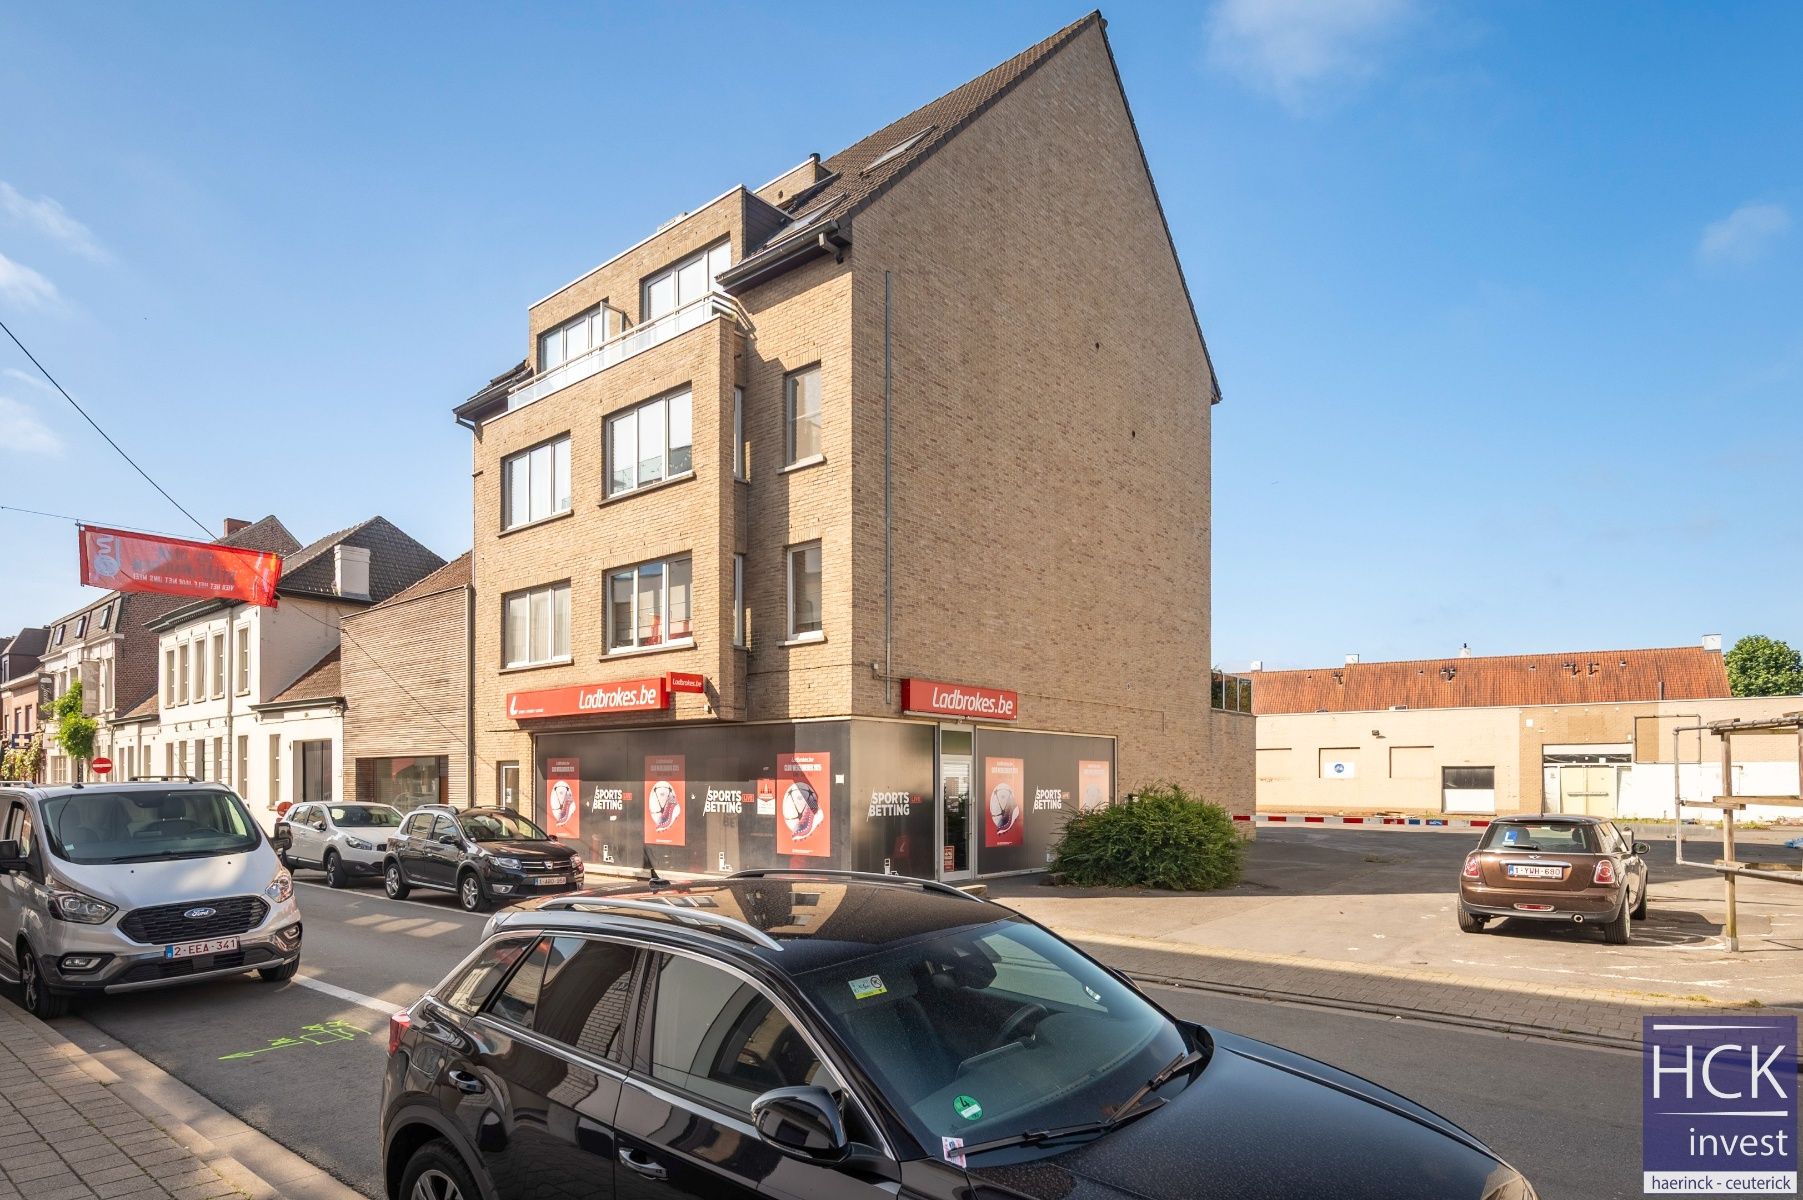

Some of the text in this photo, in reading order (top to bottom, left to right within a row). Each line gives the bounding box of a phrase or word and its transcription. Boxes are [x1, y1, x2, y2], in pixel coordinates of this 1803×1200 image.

[672, 677, 702, 688] Ladbrokes.be
[579, 684, 657, 710] Ladbrokes.be
[932, 687, 1013, 715] Ladbrokes.be
[594, 789, 623, 800] SPORTS
[707, 790, 742, 802] SPORTS
[871, 792, 909, 804] SPORTS
[1036, 789, 1061, 800] SPORTS
[592, 800, 623, 810] BETTING
[705, 801, 742, 814] BETTING
[869, 804, 910, 817] BETTING
[1034, 800, 1062, 810] BETTING
[174, 939, 235, 956] 2-EEA-341
[959, 1096, 970, 1108] 4
